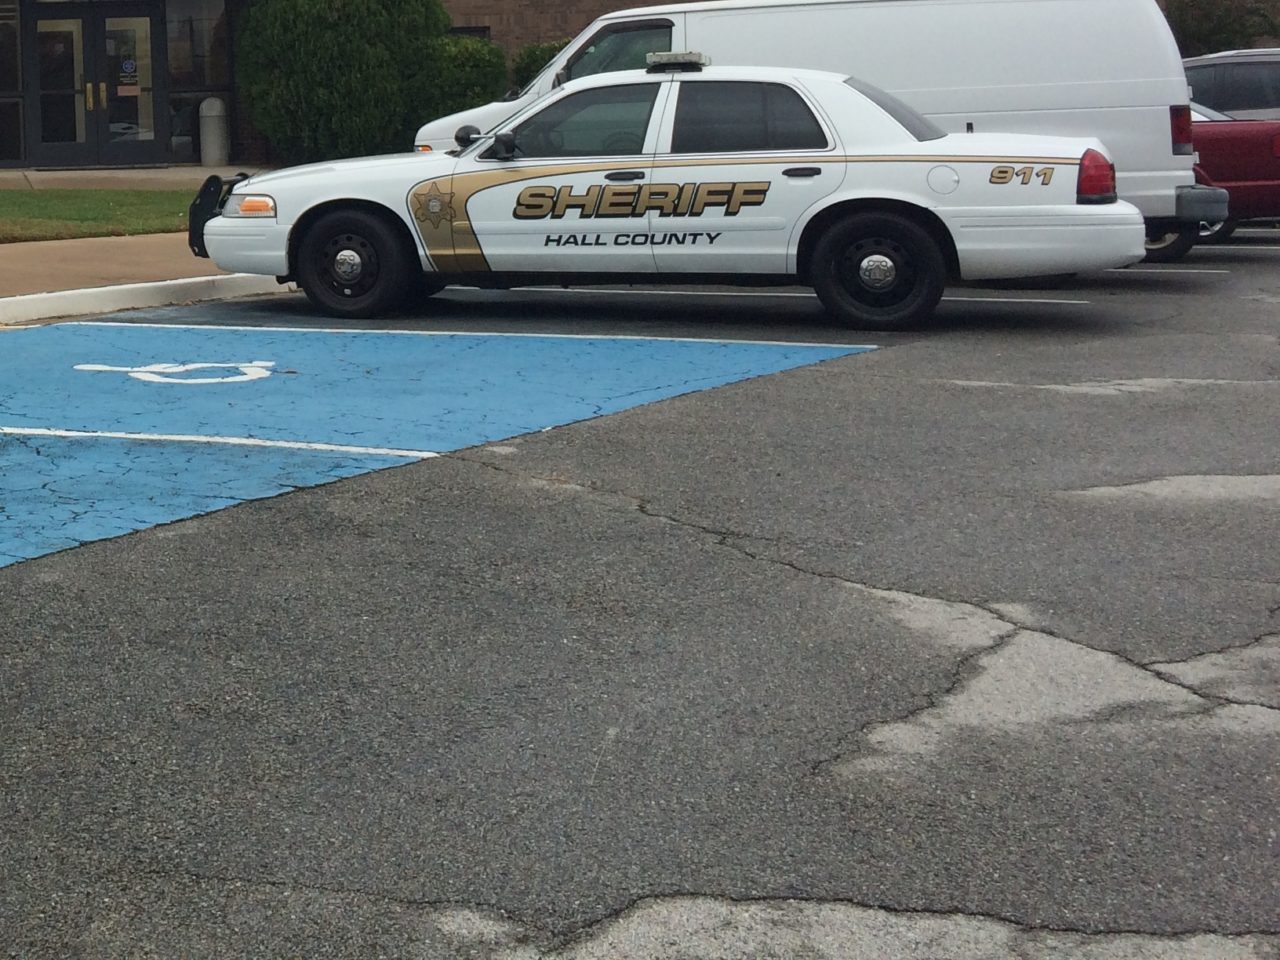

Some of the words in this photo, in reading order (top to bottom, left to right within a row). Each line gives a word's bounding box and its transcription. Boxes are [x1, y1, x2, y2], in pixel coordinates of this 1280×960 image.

[989, 166, 1055, 186] 911
[512, 181, 772, 220] SHERIFF
[544, 234, 608, 247] HALL
[613, 232, 723, 247] COUNTY
